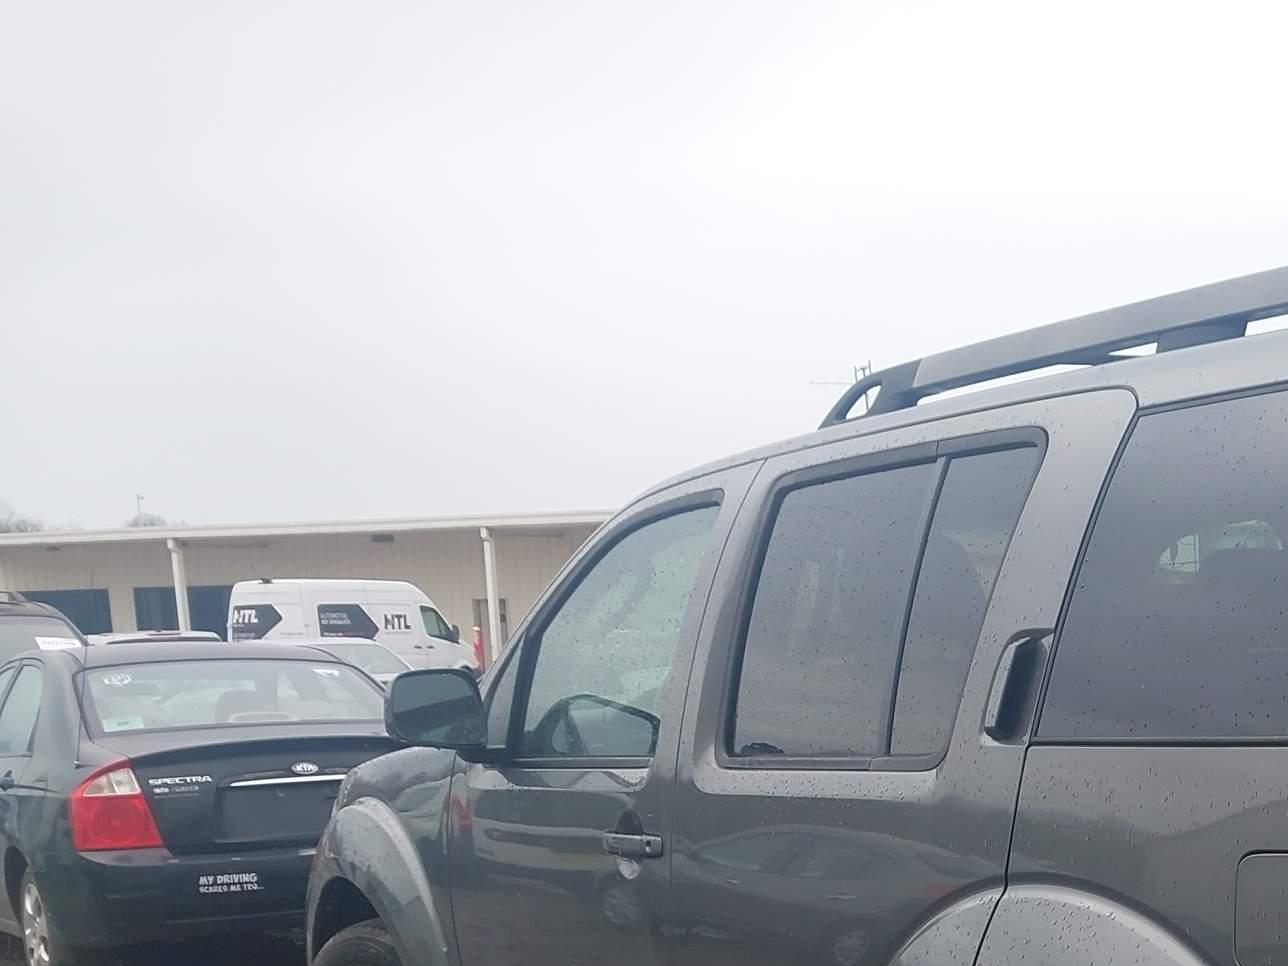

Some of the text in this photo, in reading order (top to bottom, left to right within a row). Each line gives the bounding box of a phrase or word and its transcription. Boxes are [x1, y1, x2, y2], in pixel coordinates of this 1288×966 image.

[148, 775, 213, 786] SPECTRA
[199, 872, 258, 886] MY DRIVING
